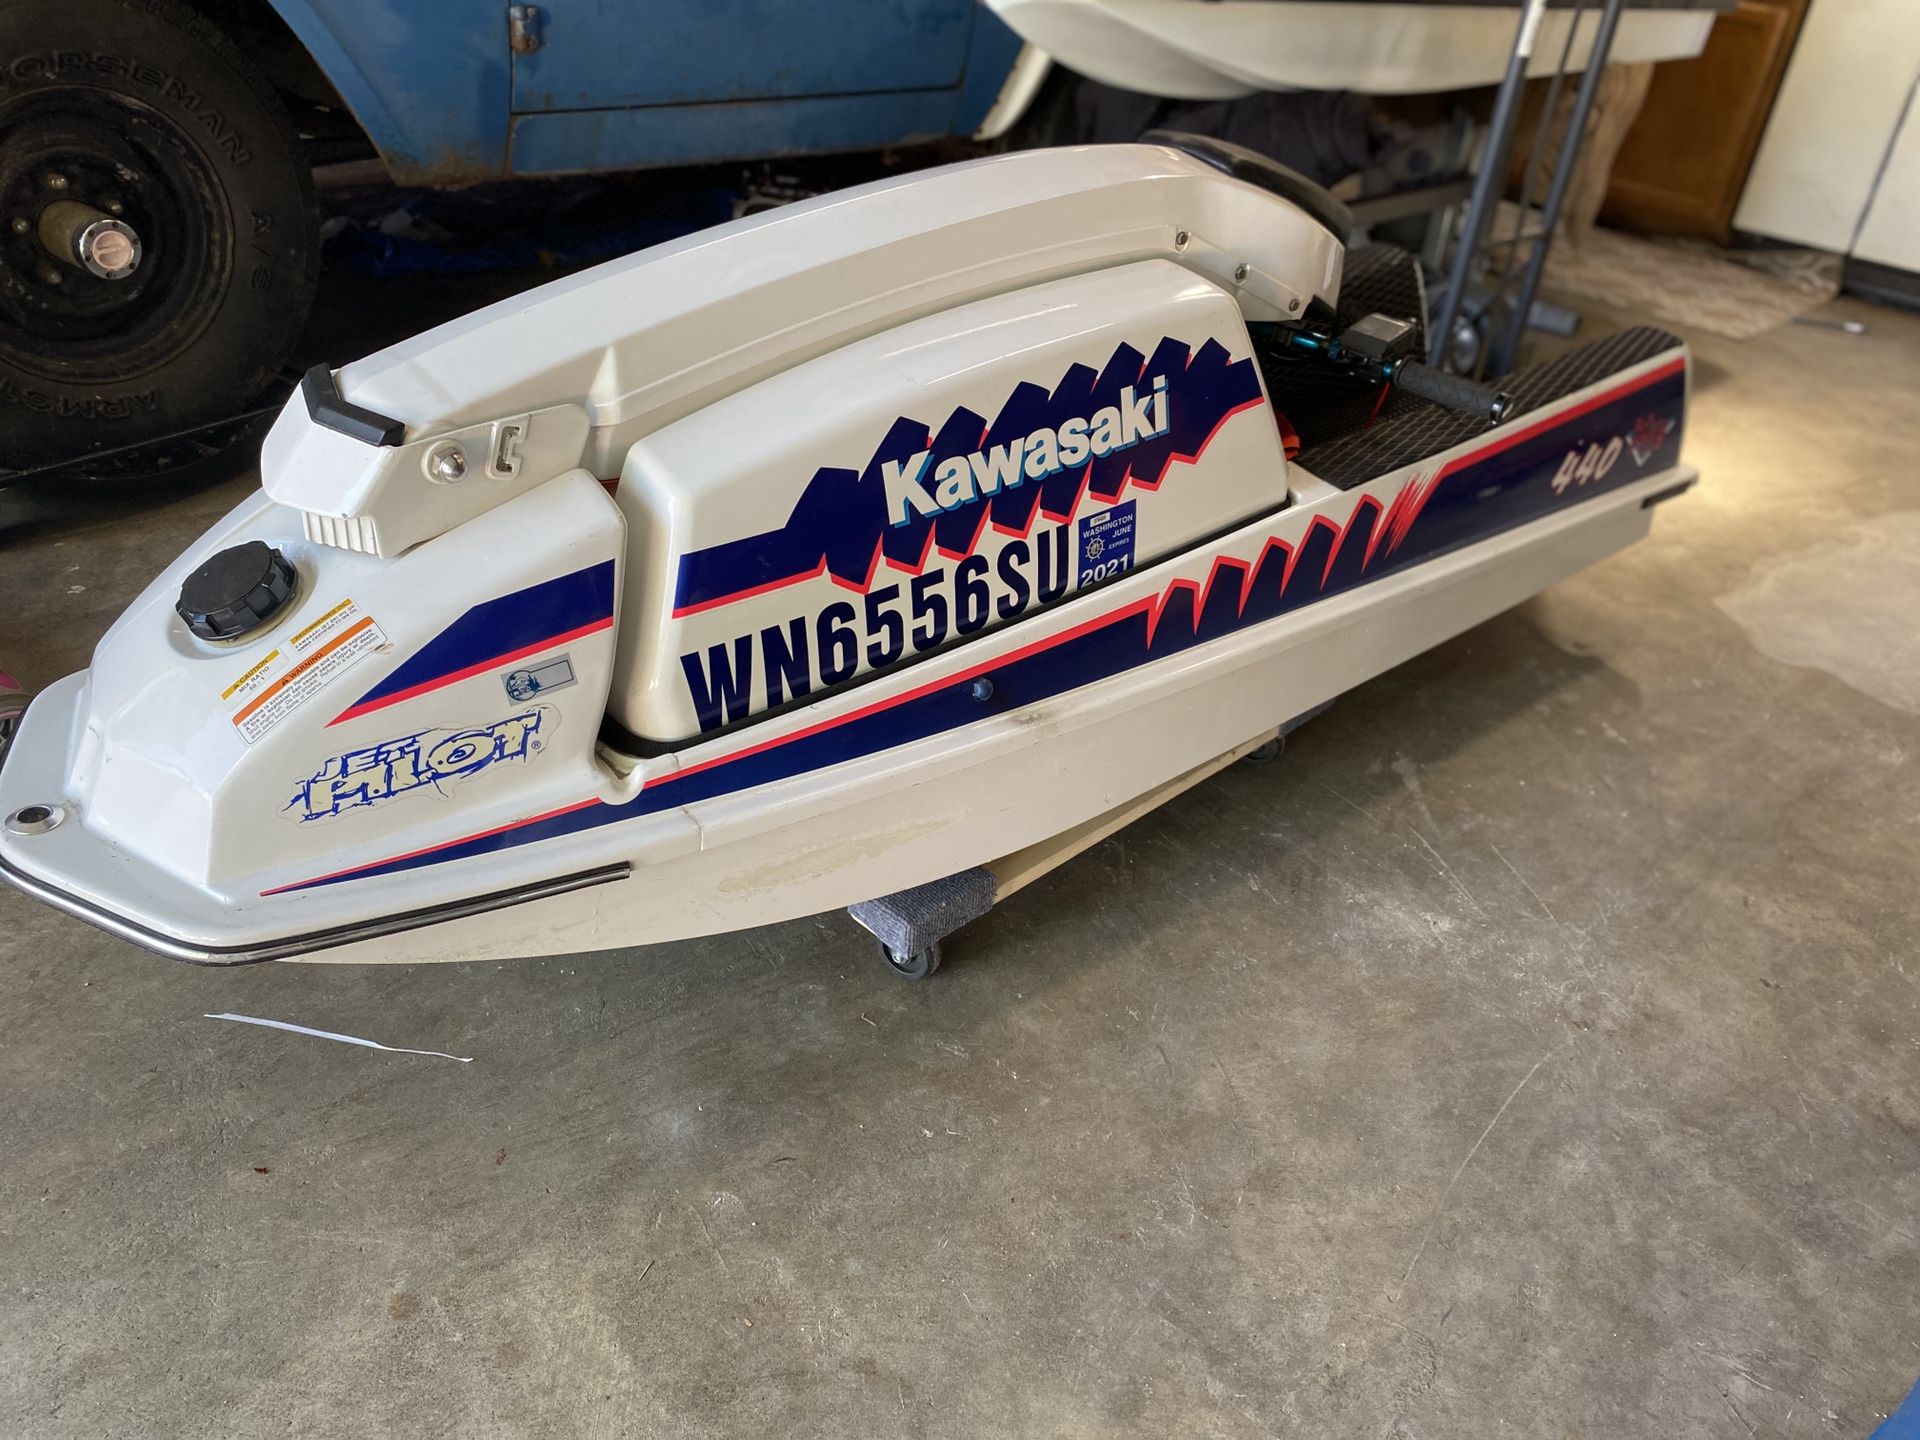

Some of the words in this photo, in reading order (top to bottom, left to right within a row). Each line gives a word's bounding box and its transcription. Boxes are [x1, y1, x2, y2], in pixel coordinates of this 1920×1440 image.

[0, 48, 251, 166] ORSEMAN
[881, 374, 1170, 526] Kawasaki
[1551, 435, 1624, 495] 440
[1082, 513, 1134, 539] WASHINGTON
[1112, 524, 1132, 538] JUNE
[1108, 537, 1130, 550] EXPIRES
[1080, 553, 1129, 588] 2021
[679, 524, 1070, 733] WN6556SU
[237, 680, 251, 693] MIX
[249, 664, 270, 683] RATIO
[238, 657, 269, 684] CAUTION
[287, 650, 324, 680] WARNING
